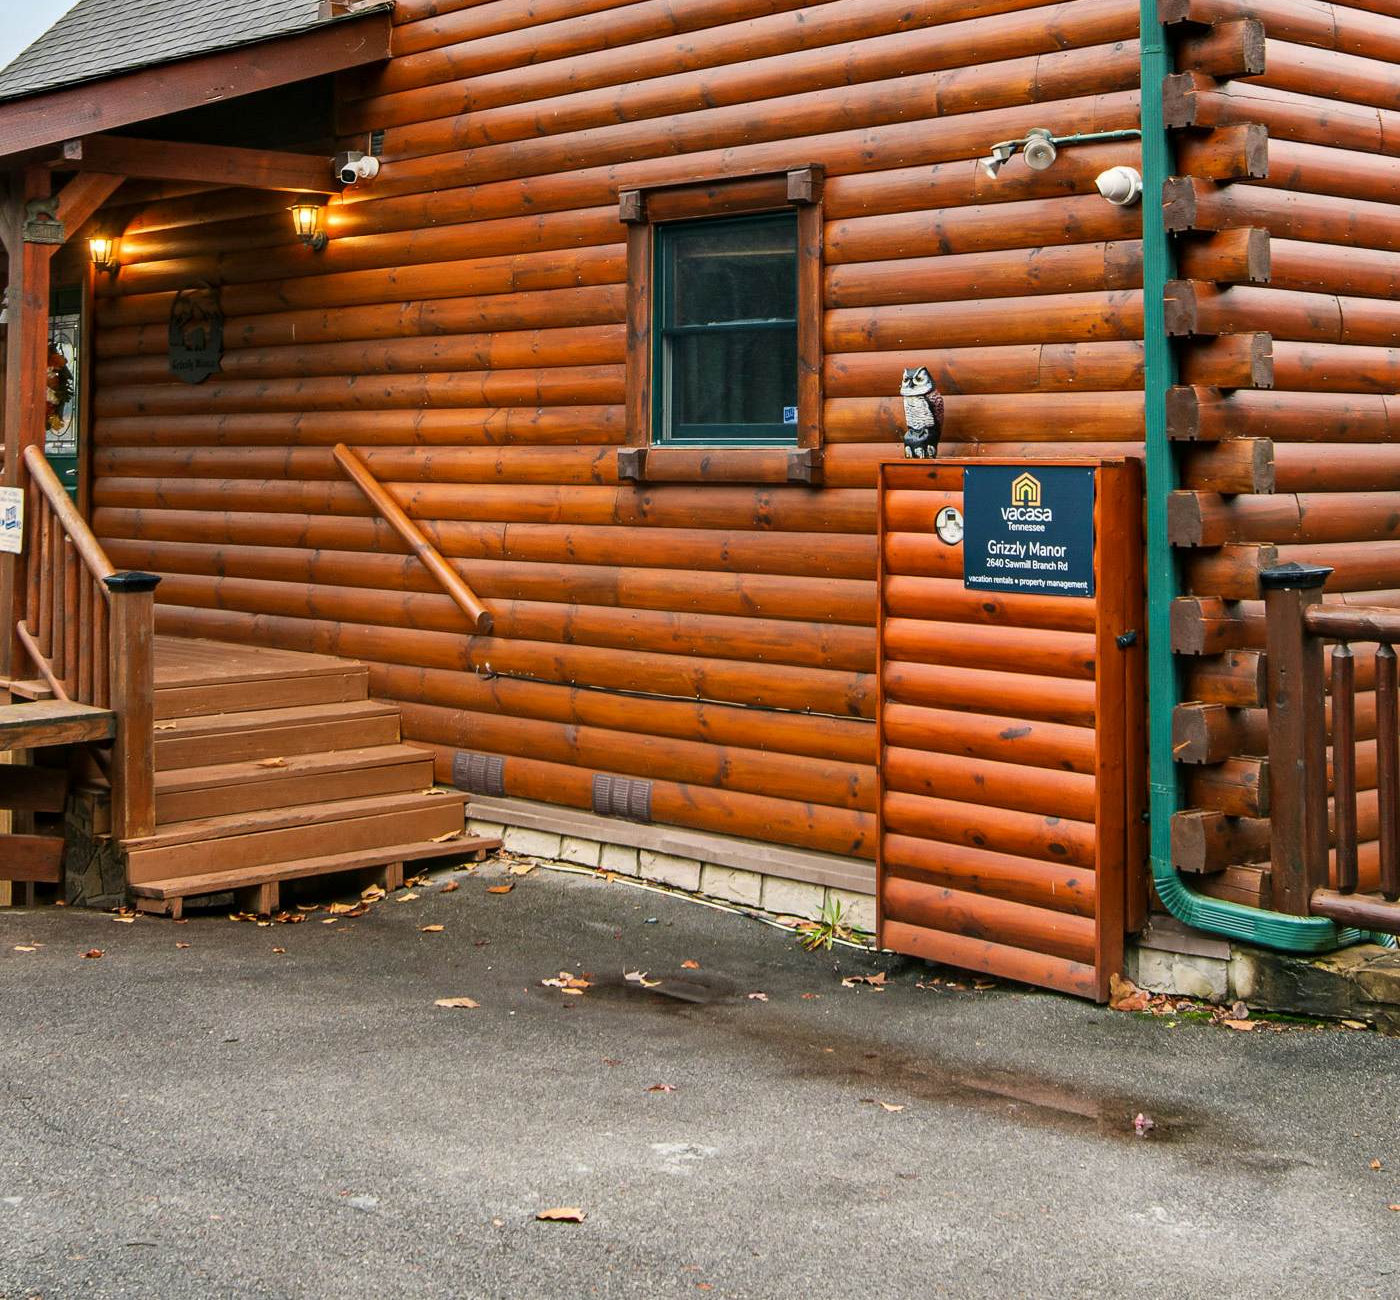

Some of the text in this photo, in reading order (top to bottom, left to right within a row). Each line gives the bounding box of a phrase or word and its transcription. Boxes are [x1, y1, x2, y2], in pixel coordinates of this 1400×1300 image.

[1001, 507, 1052, 521] vacasa
[1007, 521, 1046, 532] Tennessee
[987, 540, 1067, 558] Grizzly Manor
[986, 558, 1069, 571] 2640 Sawmill Branch Rd
[968, 575, 1089, 590] vacation rentals property management
